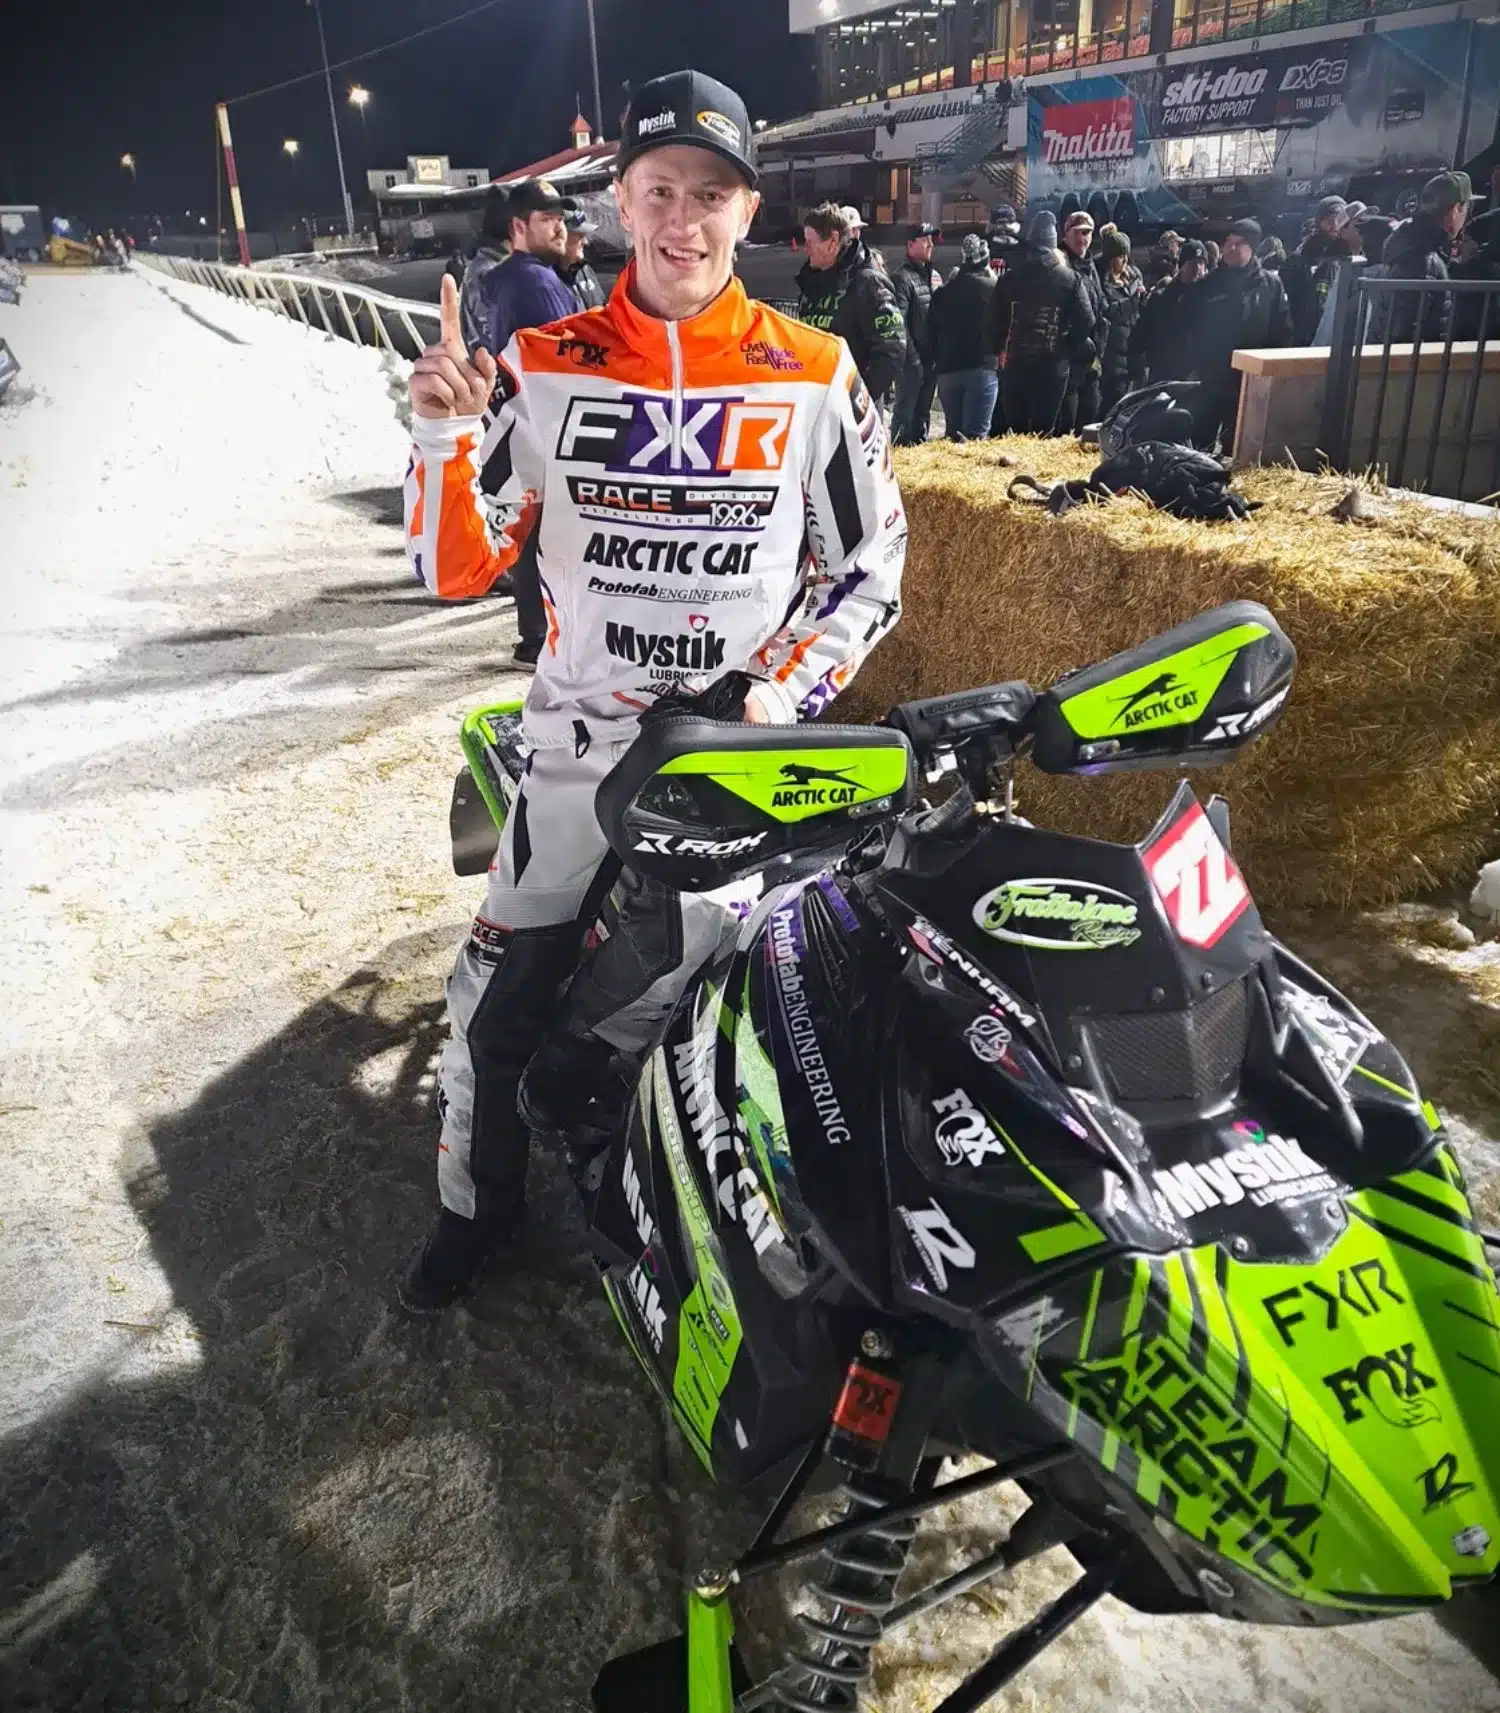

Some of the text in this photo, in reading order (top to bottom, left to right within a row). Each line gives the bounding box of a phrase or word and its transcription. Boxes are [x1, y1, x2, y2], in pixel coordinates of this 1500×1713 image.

[1163, 99, 1256, 124] FACTORY SUPPORT
[556, 340, 610, 370] FOX
[560, 400, 792, 470] FXR
[577, 482, 770, 511] RACE DIVISION
[581, 502, 760, 526] ESTABLISHED 1996
[583, 532, 759, 576] ARCTIC CAT
[605, 616, 726, 670] Mystik
[1124, 690, 1199, 729] ARCTIC CAT
[772, 787, 857, 808] ARCTIC CAT
[673, 1030, 745, 1176] ARCTIC
[932, 1087, 1006, 1168] FOX
[1152, 1134, 1327, 1219] Mystik
[1262, 1258, 1406, 1348] FXR
[1322, 1342, 1444, 1430] FOX
[1078, 1362, 1314, 1582] ARCTIC
[1144, 1345, 1323, 1538] TEAM
